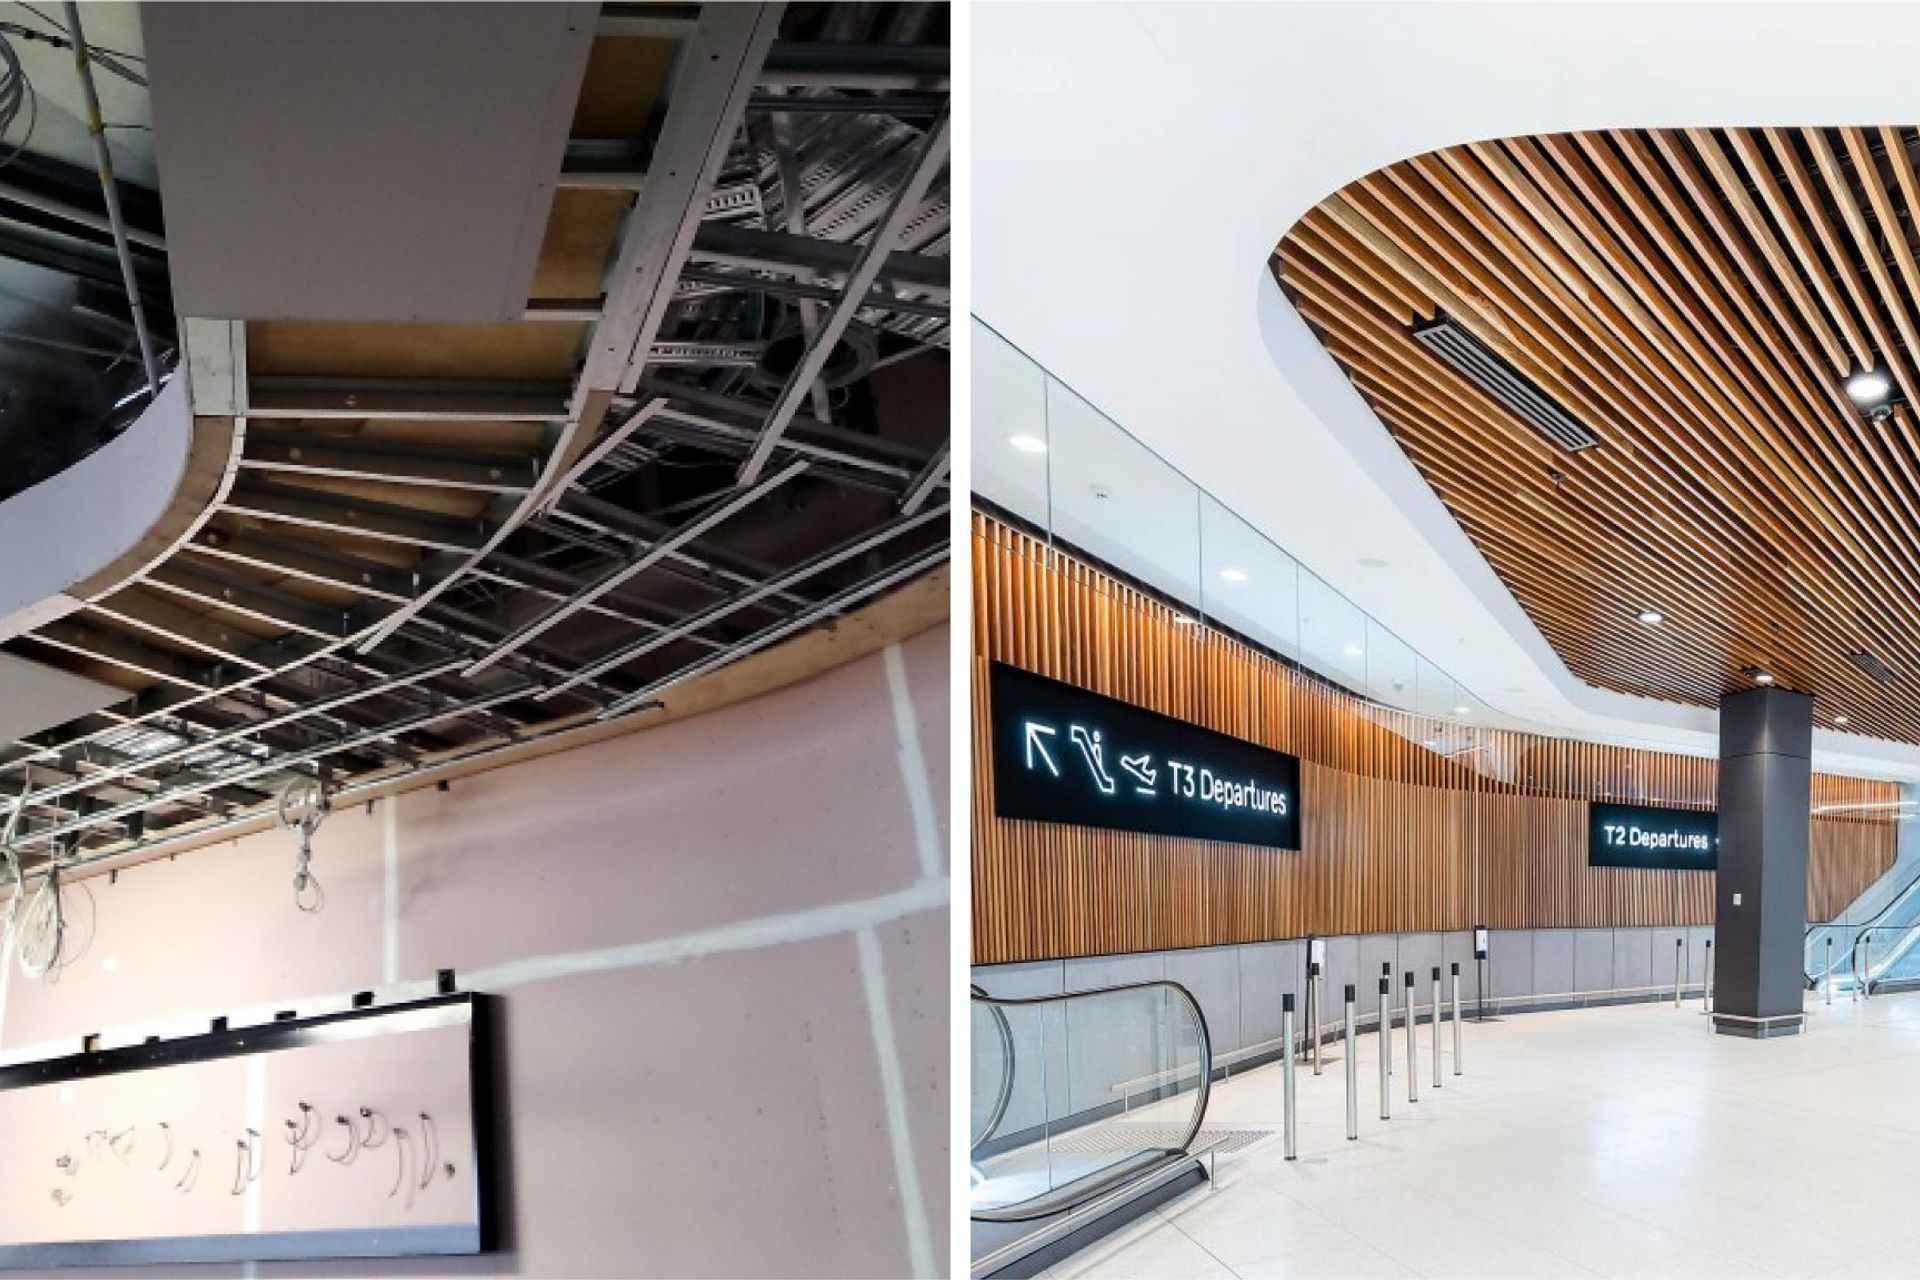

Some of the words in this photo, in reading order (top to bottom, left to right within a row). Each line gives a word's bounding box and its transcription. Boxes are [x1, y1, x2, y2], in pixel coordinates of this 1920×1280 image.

[1168, 760, 1195, 798] T3
[1201, 769, 1287, 815] Departures
[1604, 825, 1626, 845] T2
[1629, 827, 1708, 849] Departures
